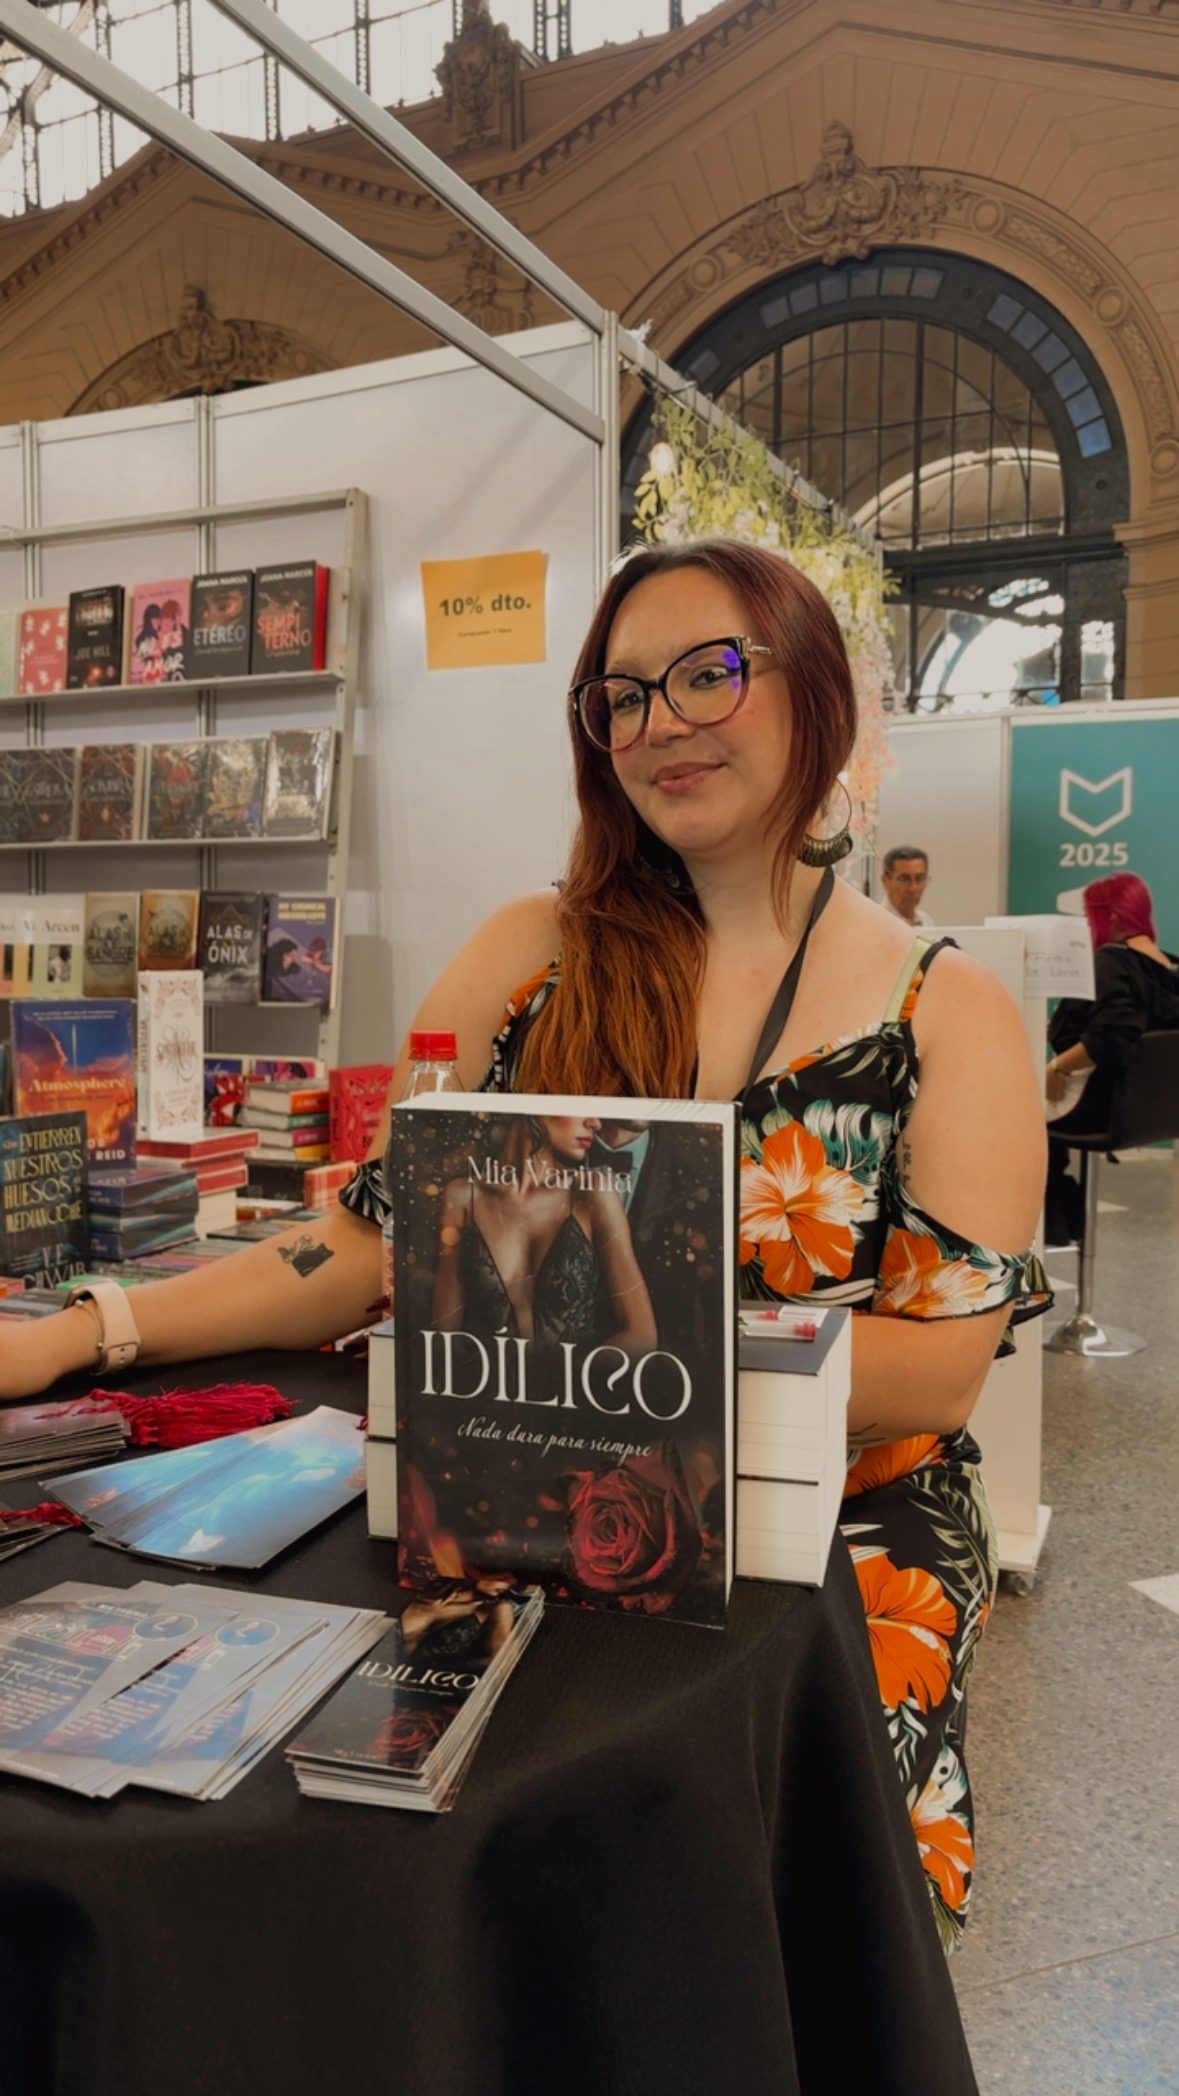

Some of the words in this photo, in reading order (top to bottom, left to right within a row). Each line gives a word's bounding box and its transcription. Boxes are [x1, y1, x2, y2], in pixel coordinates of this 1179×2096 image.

[439, 596, 484, 616] 10%
[491, 594, 531, 612] dto.
[193, 622, 247, 647] ETÉREO
[1058, 842, 1130, 867] 2025
[206, 924, 242, 940] ALAS
[207, 940, 249, 965] ÓNIX
[29, 1076, 126, 1094] Atmosphere
[19, 1126, 82, 1152] ENTIERREN
[3, 1149, 84, 1181] NUESTROS
[96, 1150, 126, 1161] REID
[467, 1154, 518, 1188] Mia
[525, 1158, 633, 1194] Varinia
[4, 1175, 72, 1210] HUESOS
[419, 1326, 692, 1420] IDÍLICO
[457, 1416, 503, 1442] Nada
[505, 1422, 545, 1448] dura
[541, 1432, 586, 1458] para
[589, 1435, 654, 1467] siempre
